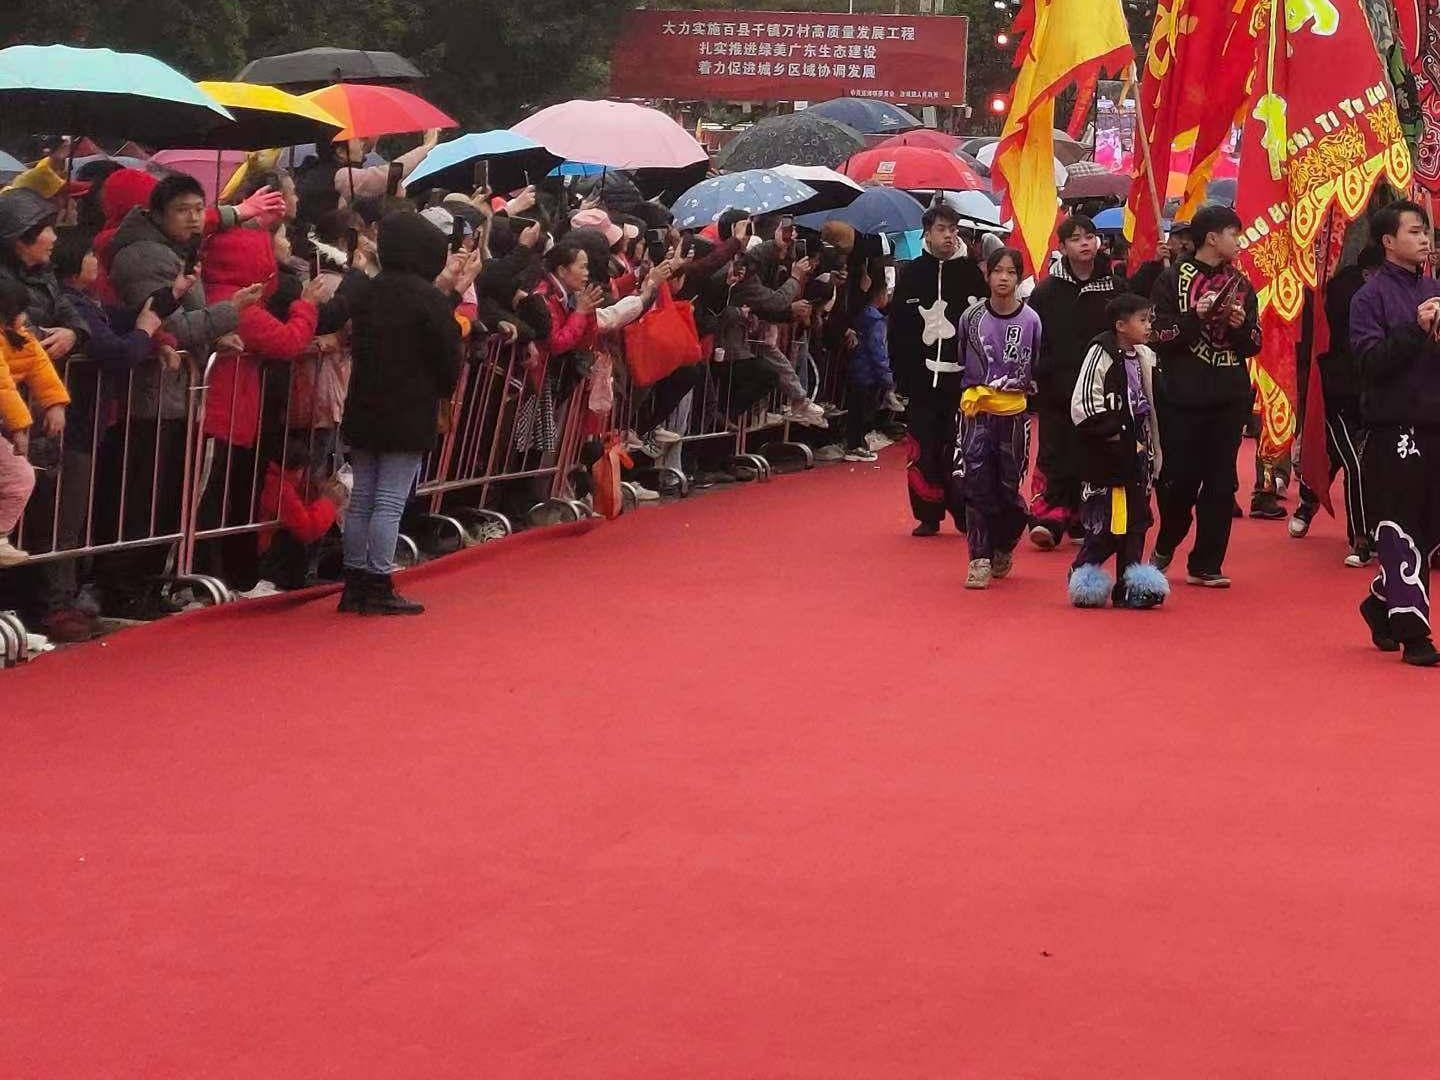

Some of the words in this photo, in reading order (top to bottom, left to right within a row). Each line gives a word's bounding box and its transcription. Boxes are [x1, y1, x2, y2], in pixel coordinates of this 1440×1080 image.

[662, 21, 916, 41] 大力实施百县千镇万村高质量发展工程
[699, 41, 877, 59] 扎实推进绿美广东生态建设
[697, 61, 876, 79] 着力促进城乡区域协调发展
